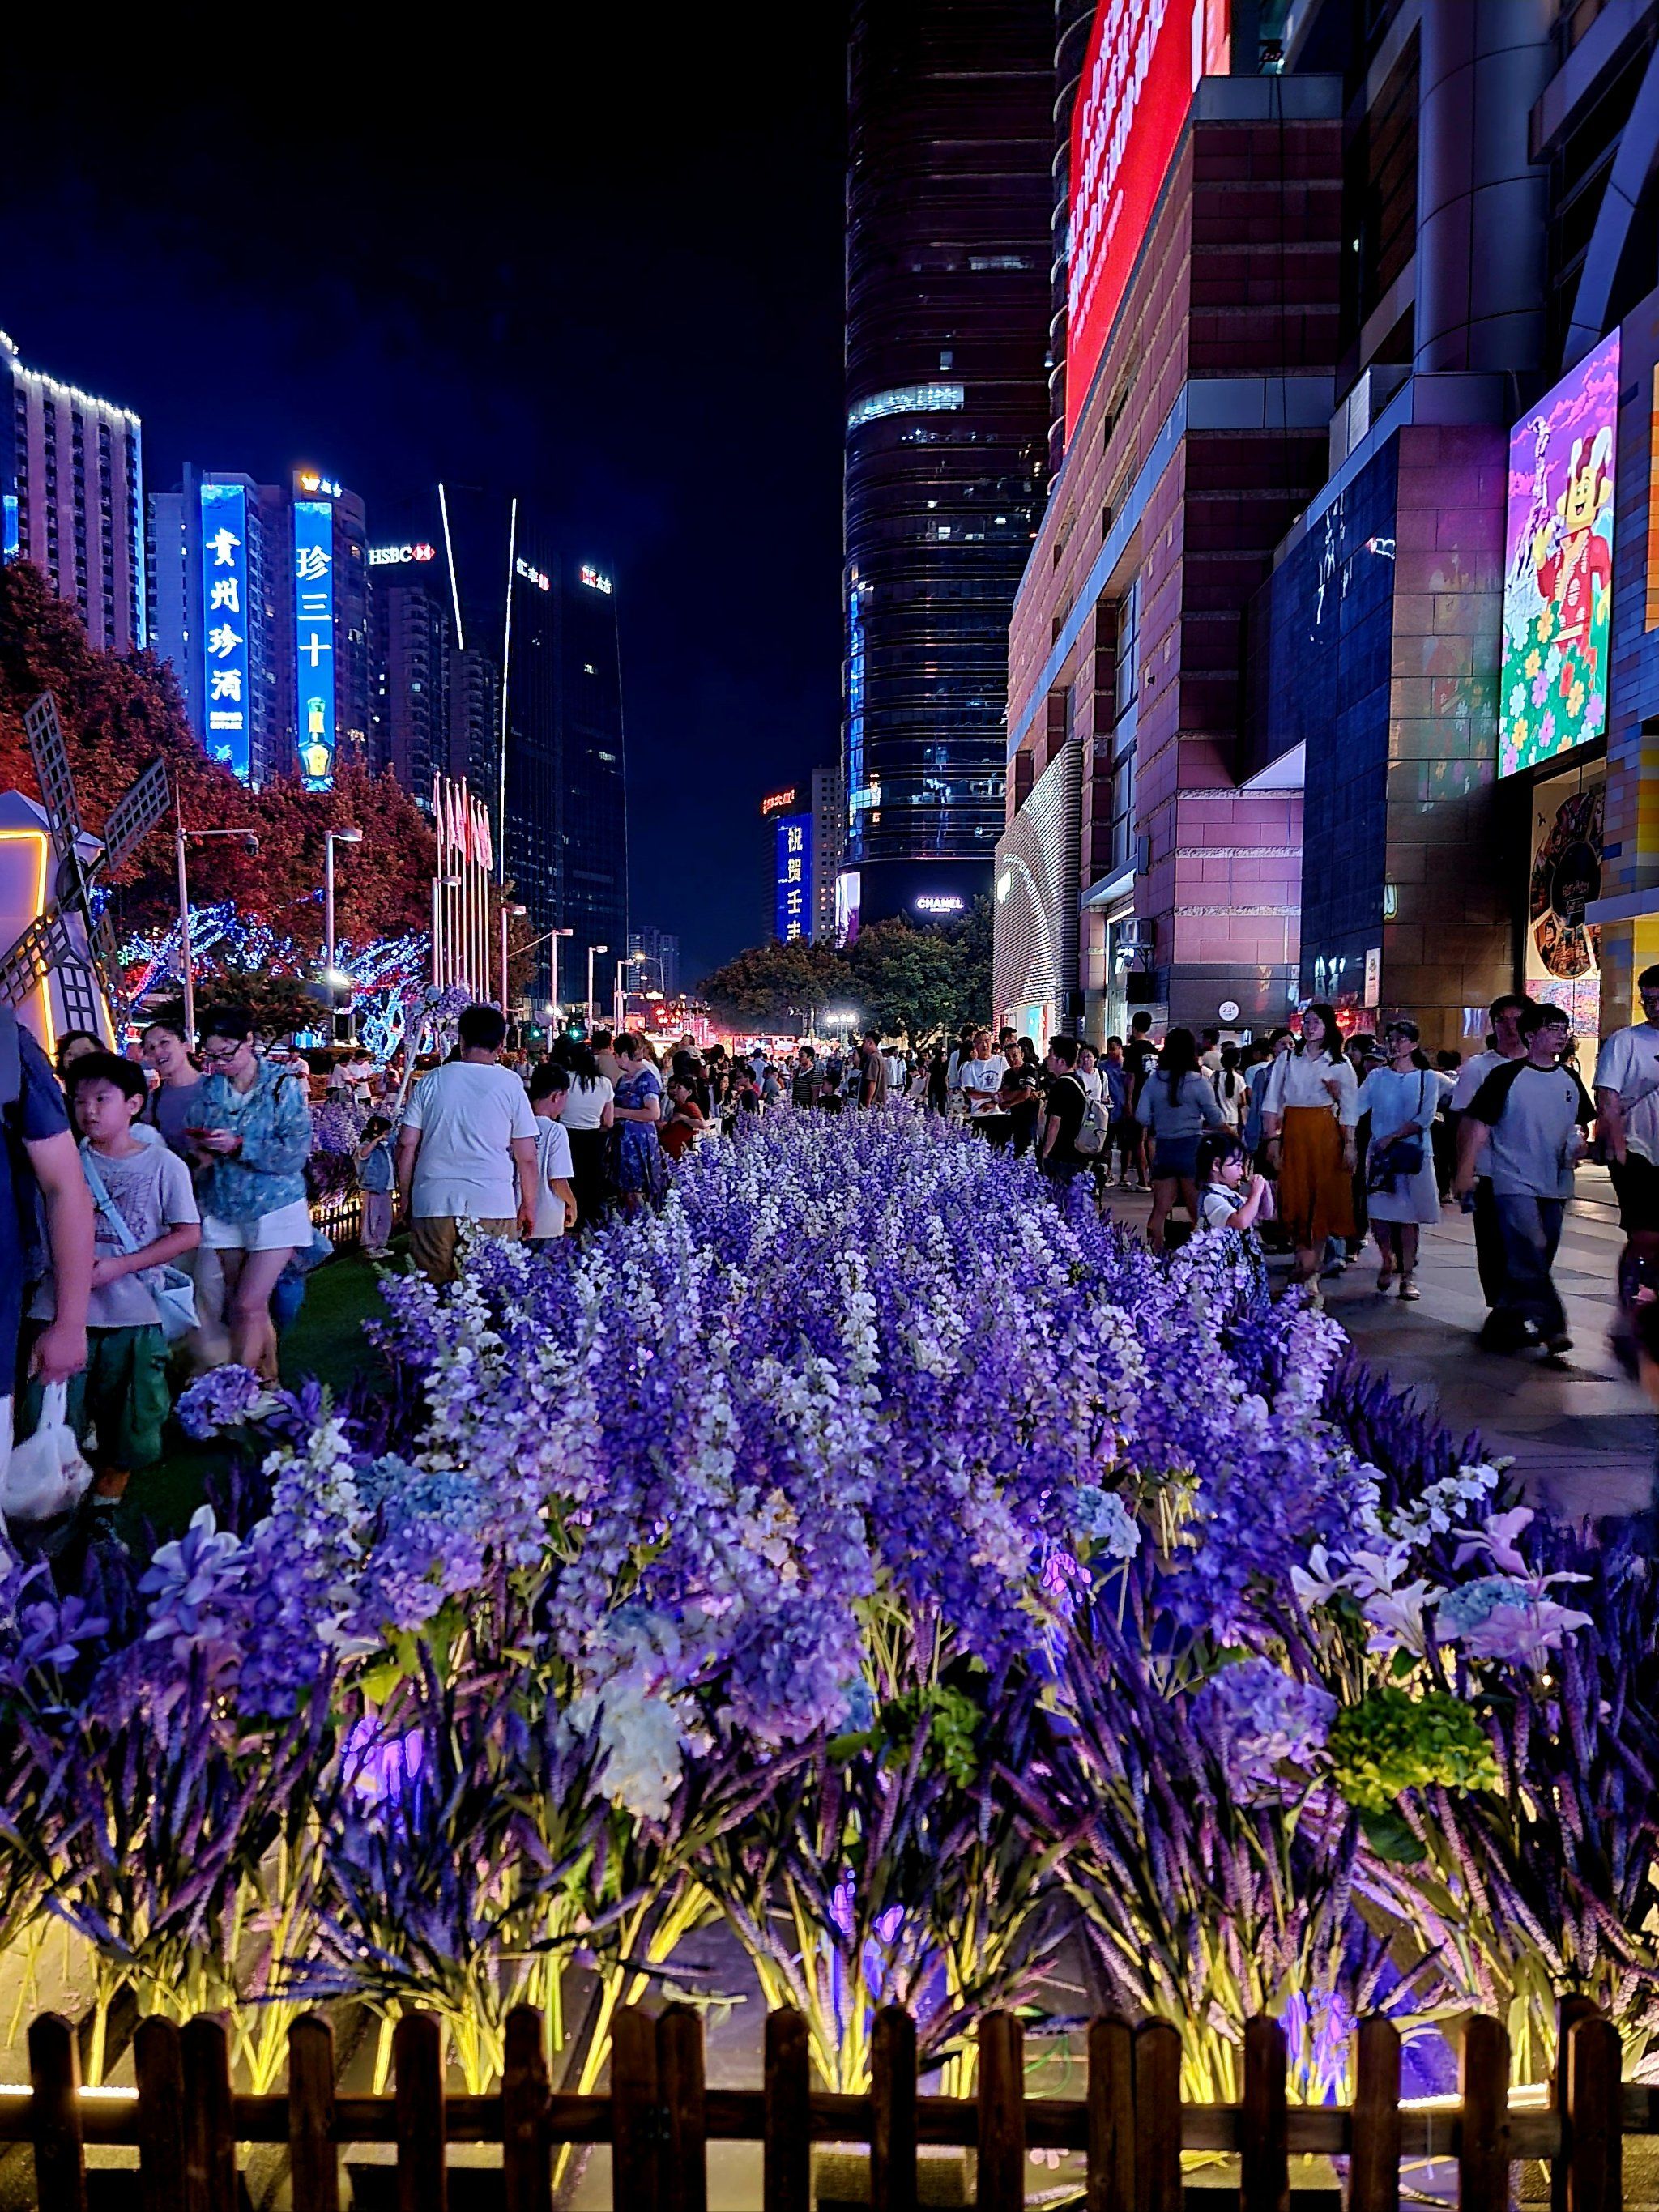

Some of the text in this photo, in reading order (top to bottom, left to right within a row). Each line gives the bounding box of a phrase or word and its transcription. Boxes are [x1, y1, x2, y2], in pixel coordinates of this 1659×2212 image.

[368, 546, 412, 565] HSBC
[296, 545, 333, 667] 珍三十
[916, 897, 964, 909] CHANEL
